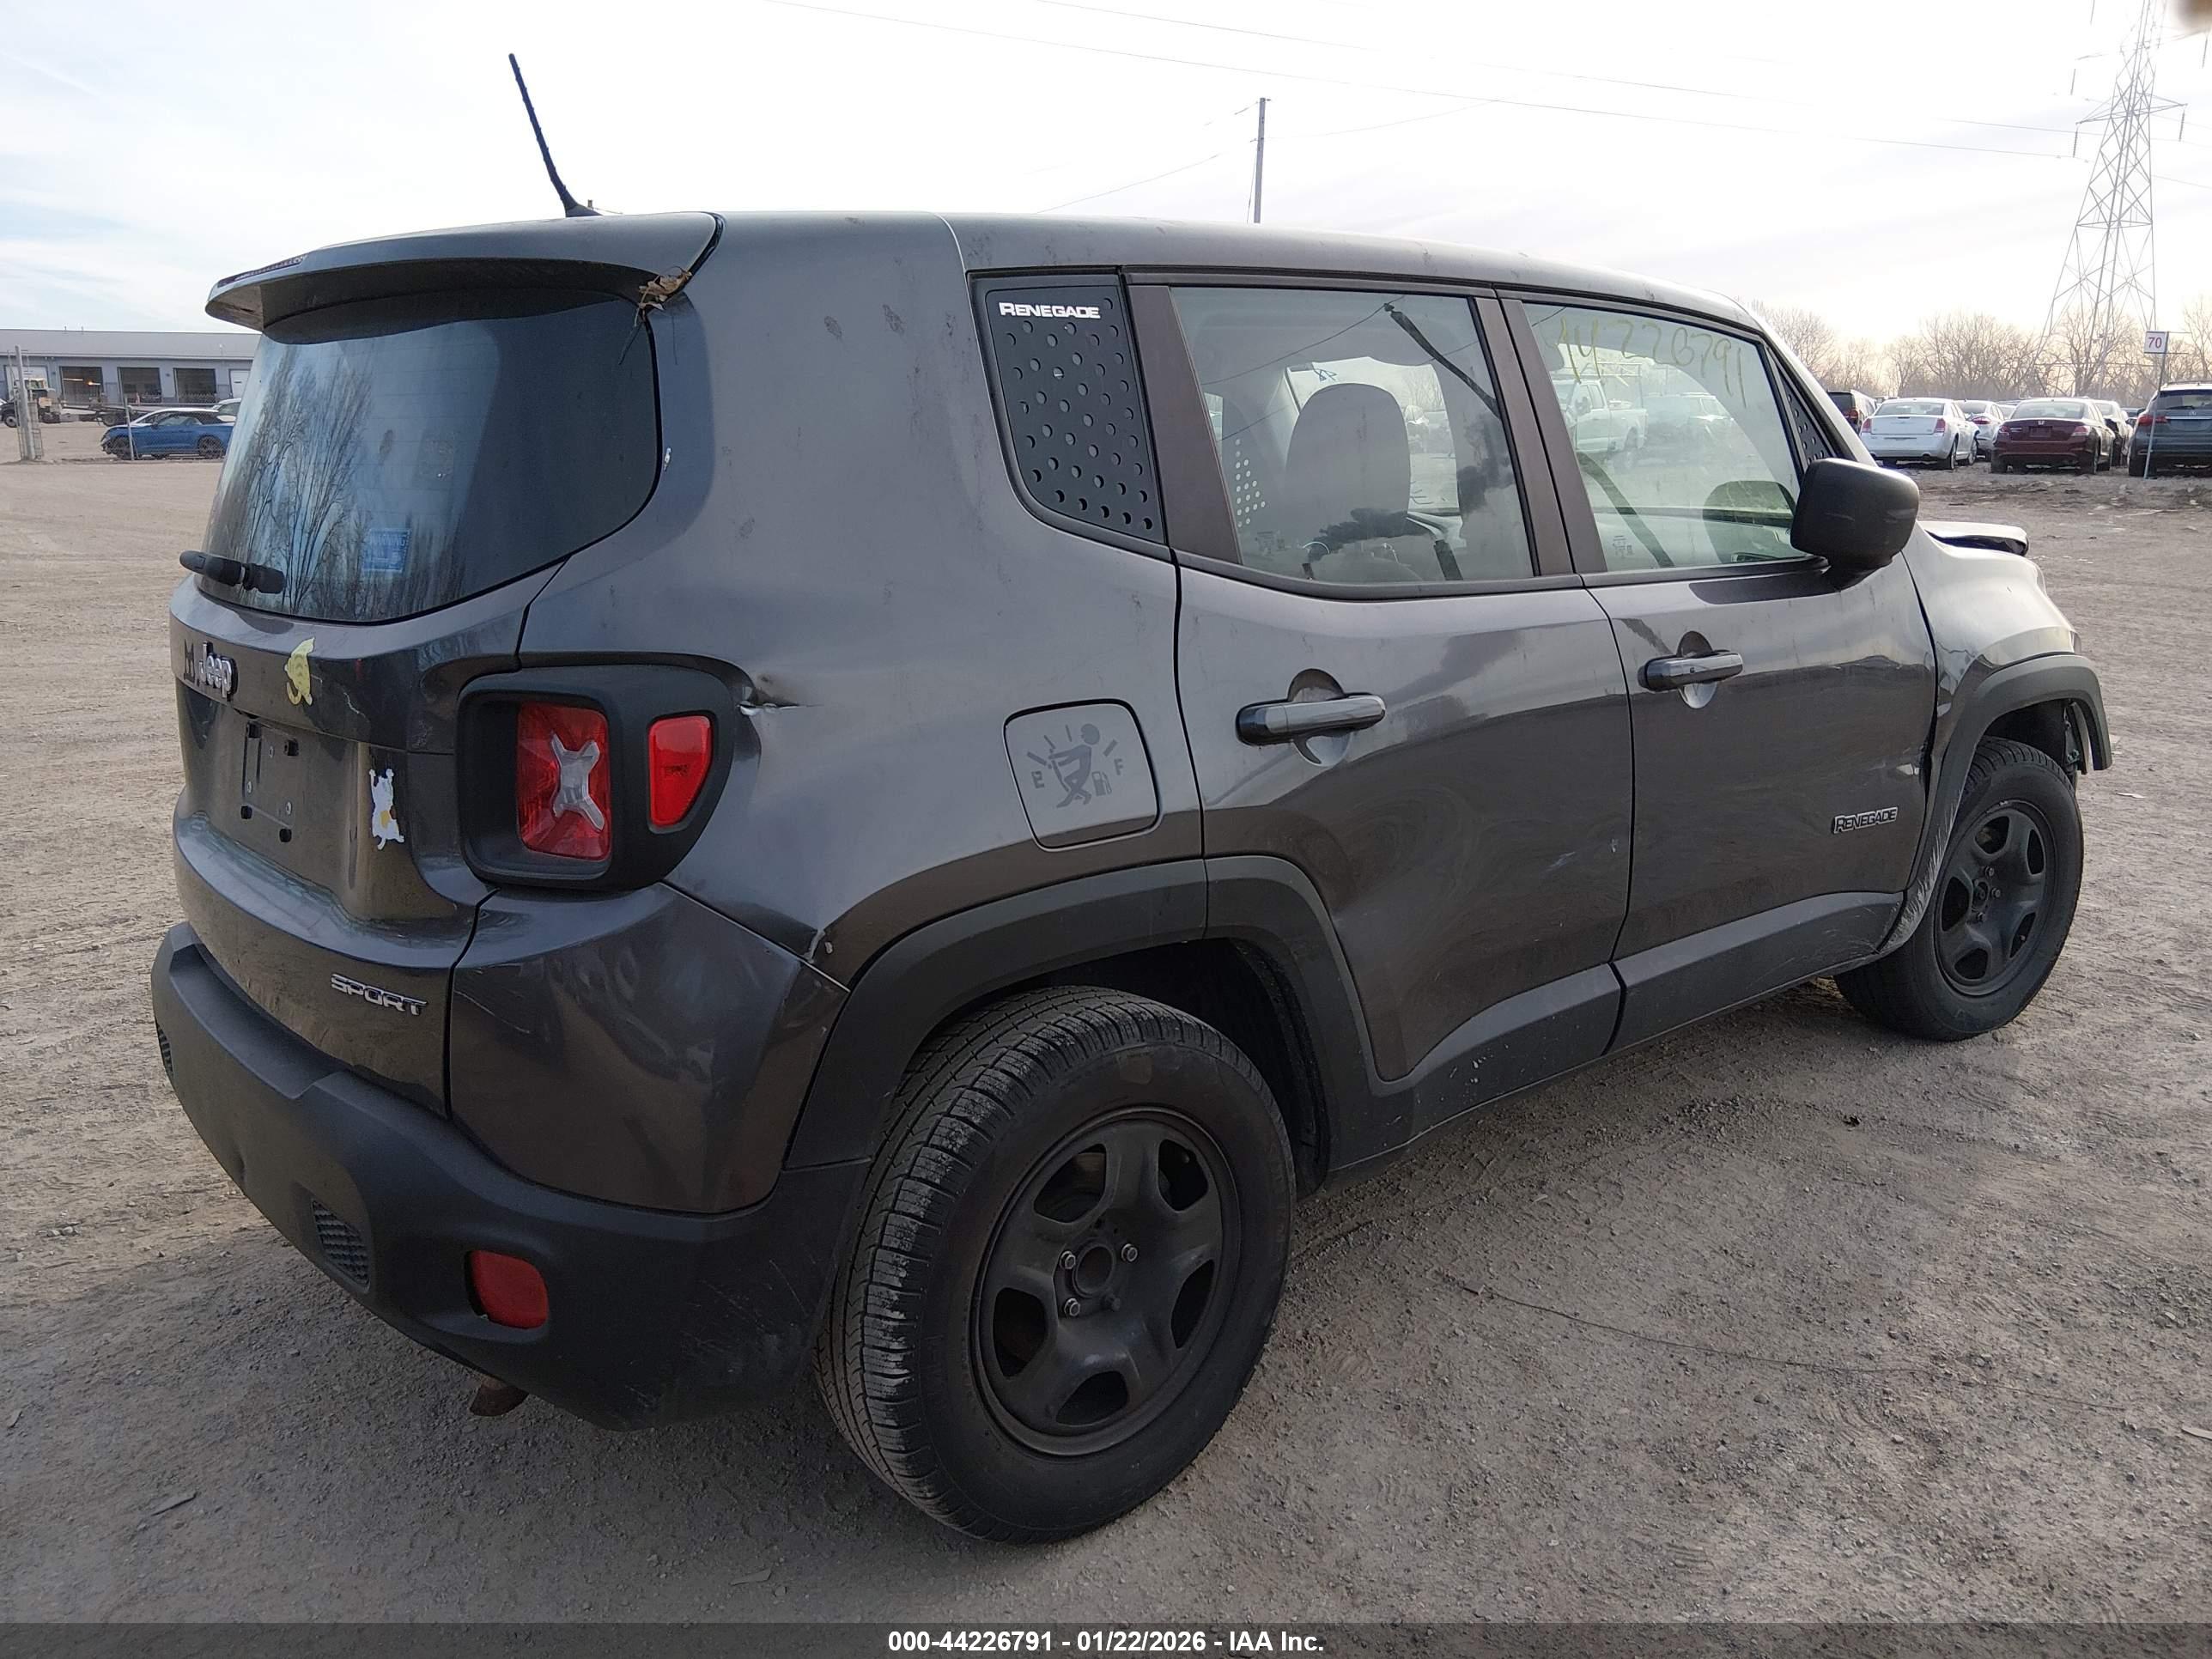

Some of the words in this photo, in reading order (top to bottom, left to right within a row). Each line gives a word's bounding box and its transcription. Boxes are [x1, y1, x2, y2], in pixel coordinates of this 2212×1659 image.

[999, 301, 1101, 319] RENEGADE
[2148, 337, 2162, 349] 70
[198, 642, 235, 700] Jeep
[1832, 806, 1899, 834] RENEGADE
[331, 973, 428, 1016] SPORT
